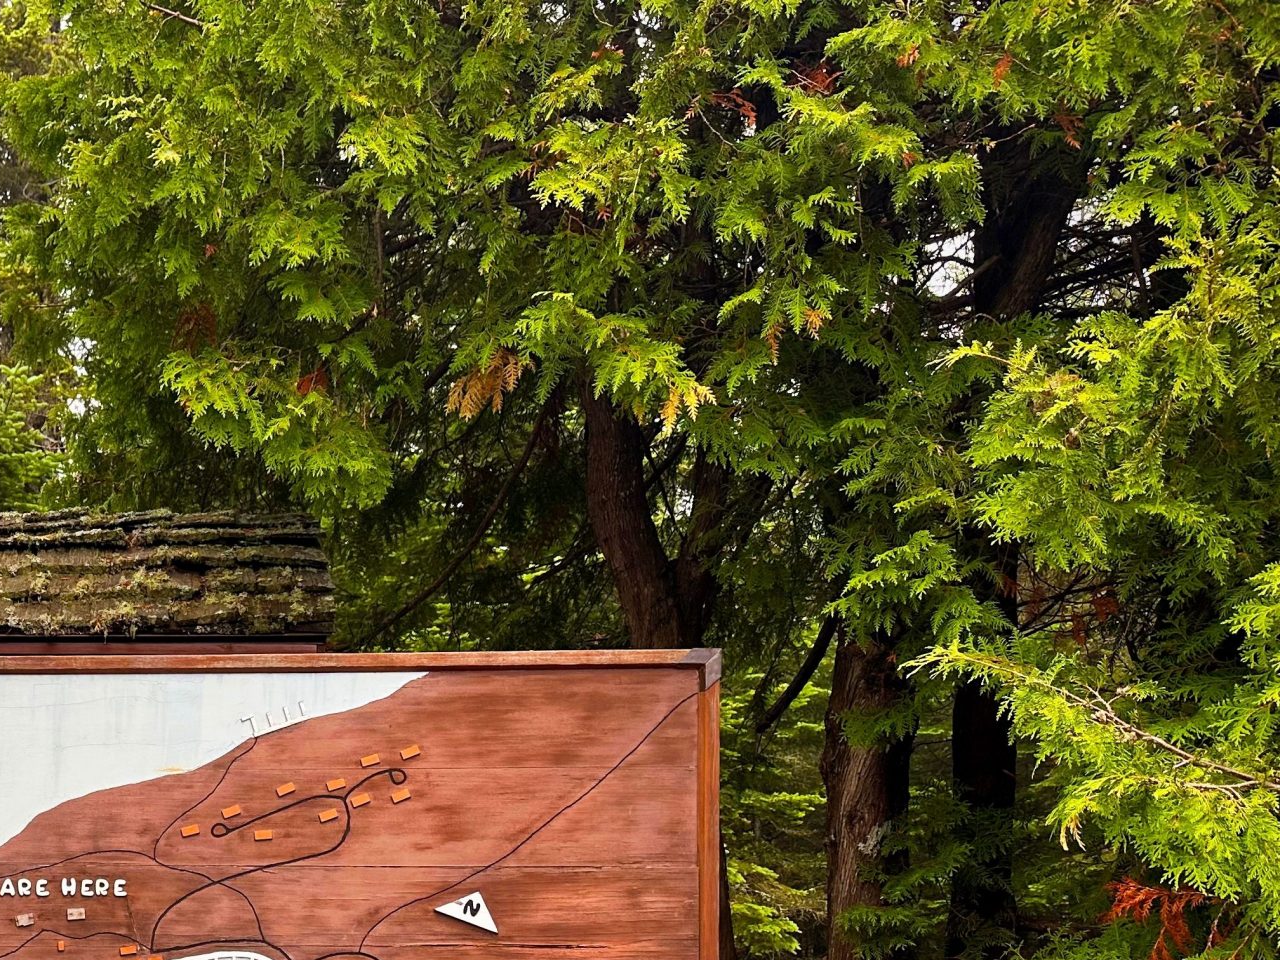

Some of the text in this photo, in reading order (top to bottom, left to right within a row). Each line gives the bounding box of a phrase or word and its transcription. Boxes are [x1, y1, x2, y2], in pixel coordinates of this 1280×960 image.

[0, 877, 50, 897] ARE
[61, 877, 128, 897] HERE
[463, 899, 481, 917] N
